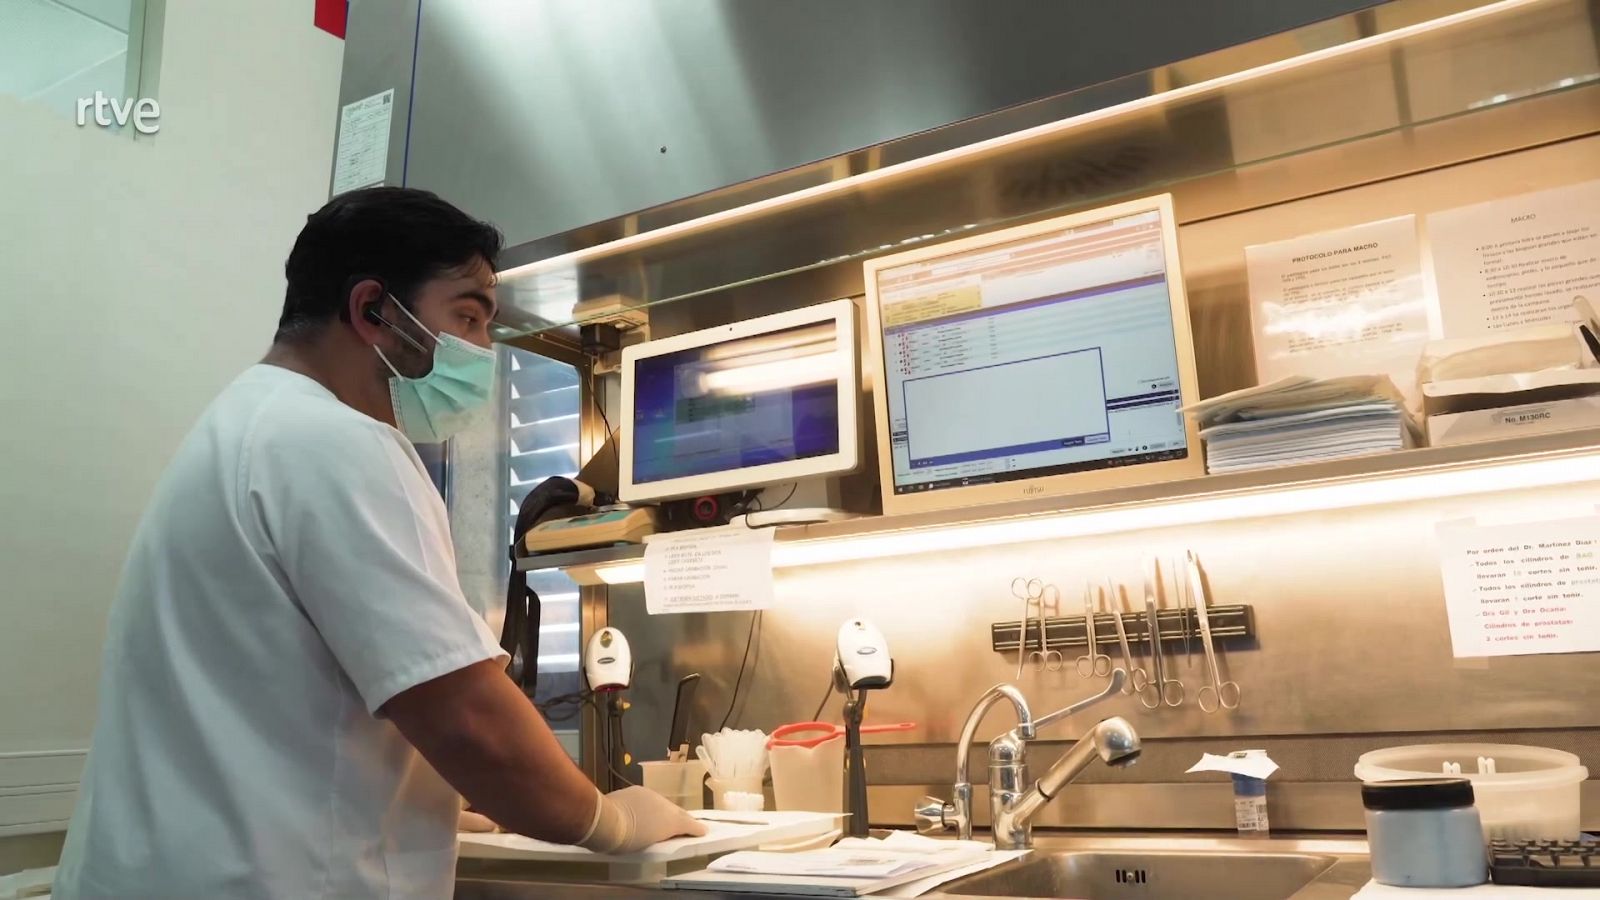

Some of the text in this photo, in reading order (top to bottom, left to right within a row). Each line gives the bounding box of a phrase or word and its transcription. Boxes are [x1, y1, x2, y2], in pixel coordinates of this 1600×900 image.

[1510, 213, 1536, 224] MACRO
[1292, 242, 1379, 263] PROTOCOLO PARA MACRO
[1521, 555, 1554, 564] cilindros
[1520, 581, 1553, 589] cilindros
[1484, 622, 1517, 630] Cilindros
[1495, 634, 1518, 642] cortes
